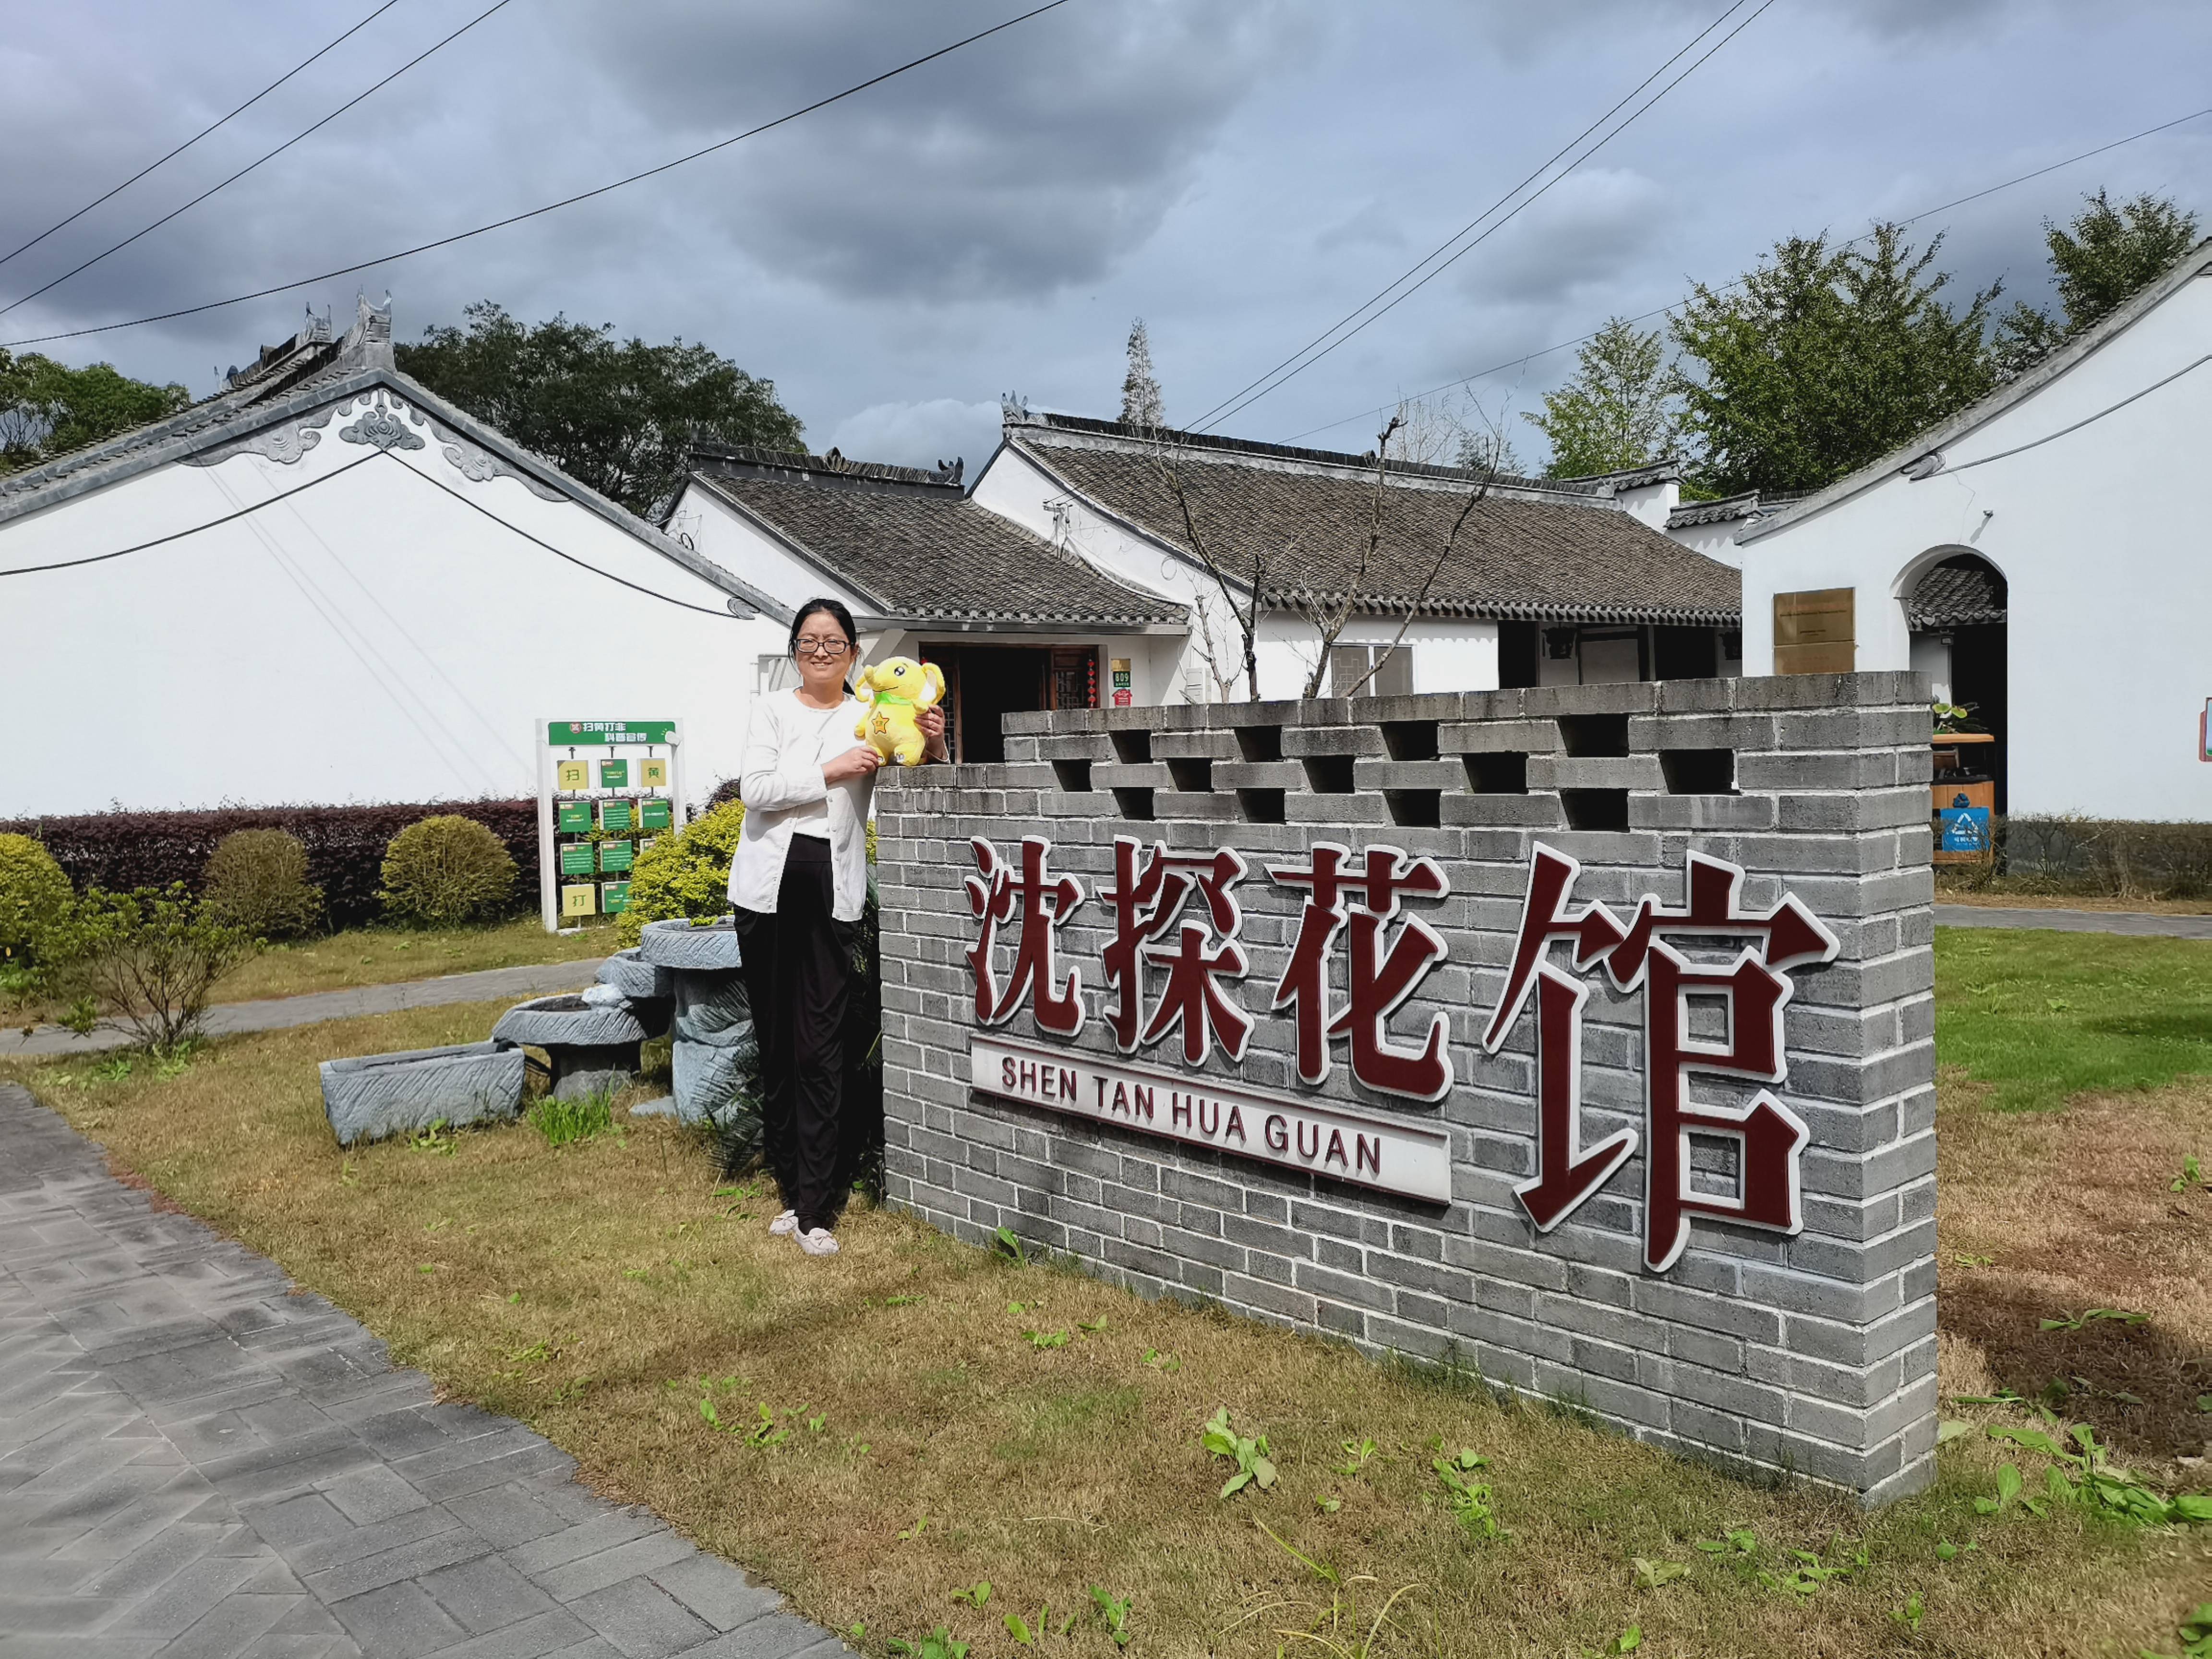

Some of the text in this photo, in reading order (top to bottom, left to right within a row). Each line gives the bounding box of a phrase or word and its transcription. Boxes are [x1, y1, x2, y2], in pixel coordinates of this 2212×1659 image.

[1115, 673, 1129, 682] 809
[583, 722, 626, 732] 扫黄打非
[566, 769, 579, 781] 扫
[572, 895, 586, 907] 打
[964, 833, 1840, 1273] 沈探花馆
[1001, 1056, 1381, 1175] SHEN TAN HUA GUAN
